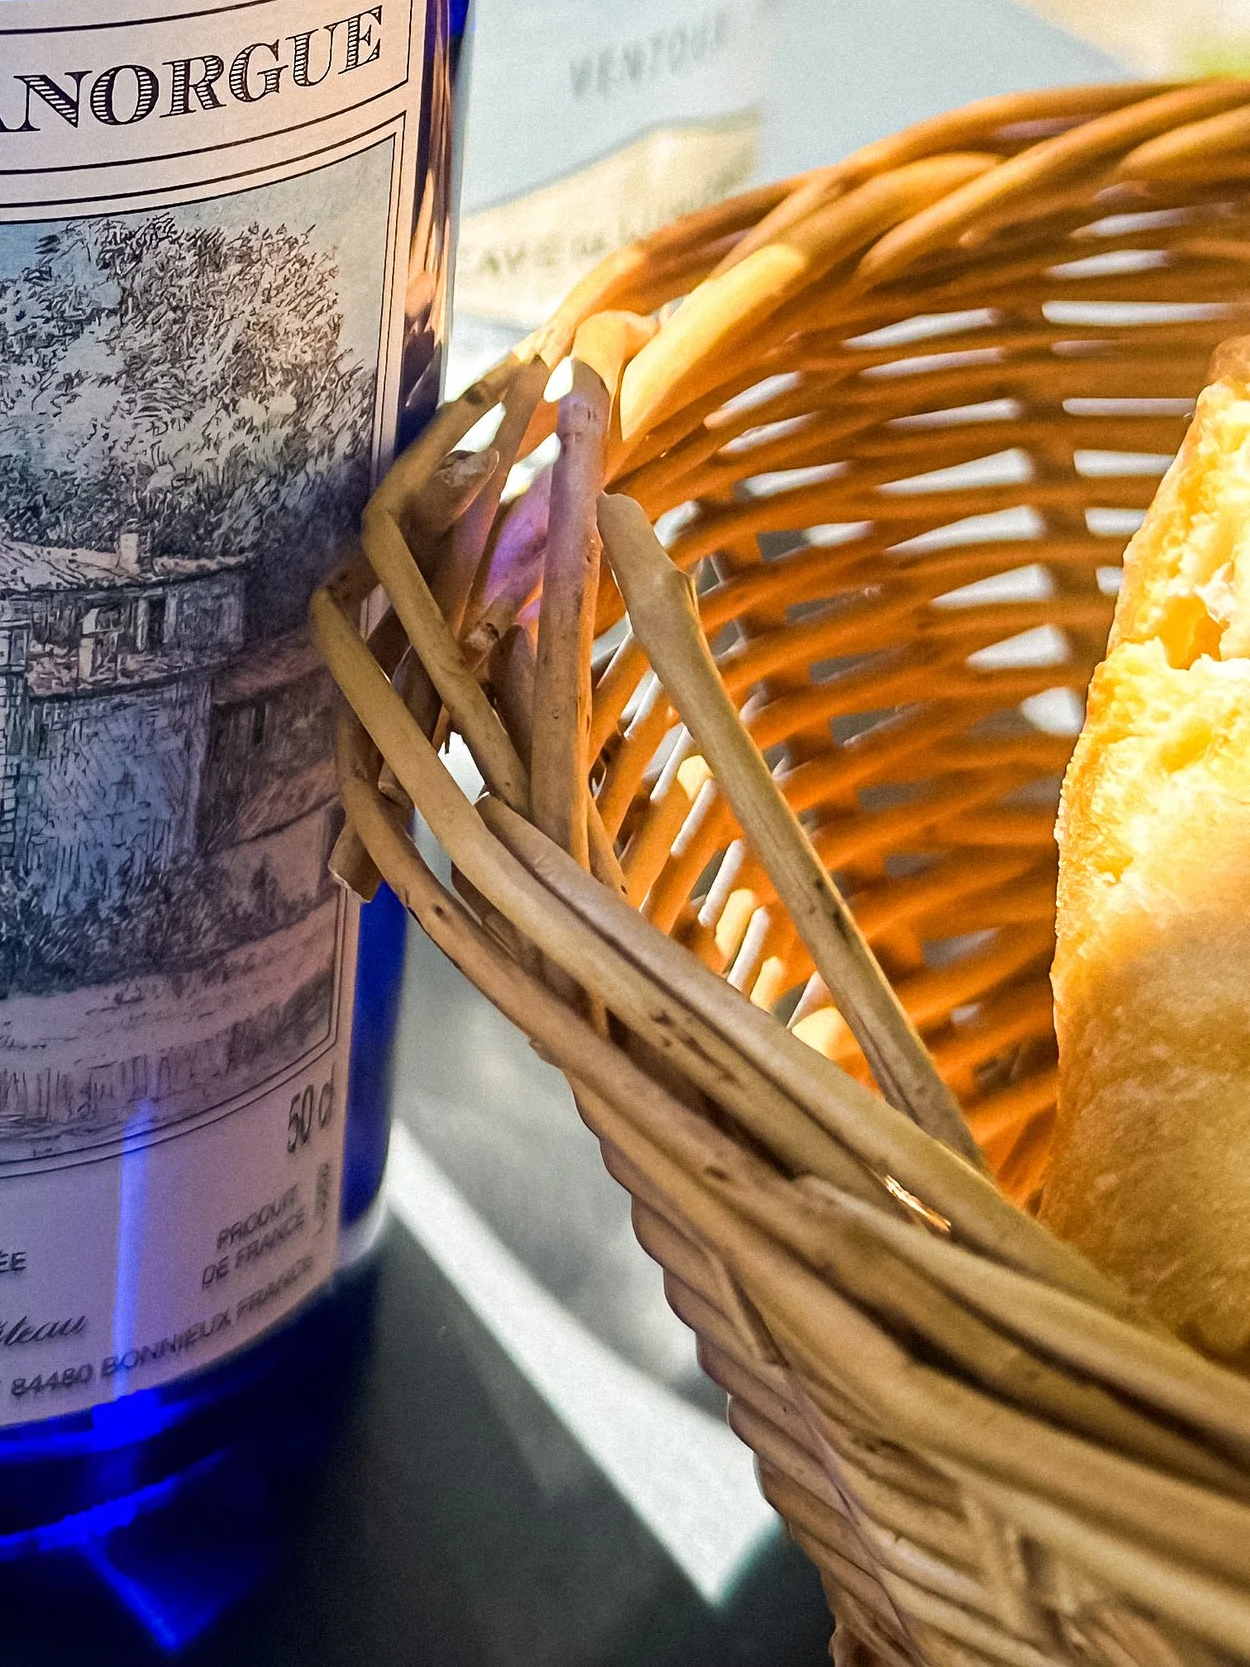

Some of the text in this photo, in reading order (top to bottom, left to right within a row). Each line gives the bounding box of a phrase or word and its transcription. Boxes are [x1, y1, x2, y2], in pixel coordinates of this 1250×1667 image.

[287, 1083, 314, 1155] 50
[201, 1206, 305, 1289] DE FRANCE
[10, 1363, 95, 1398] 84480
[101, 1309, 232, 1378] BONNIEUX
